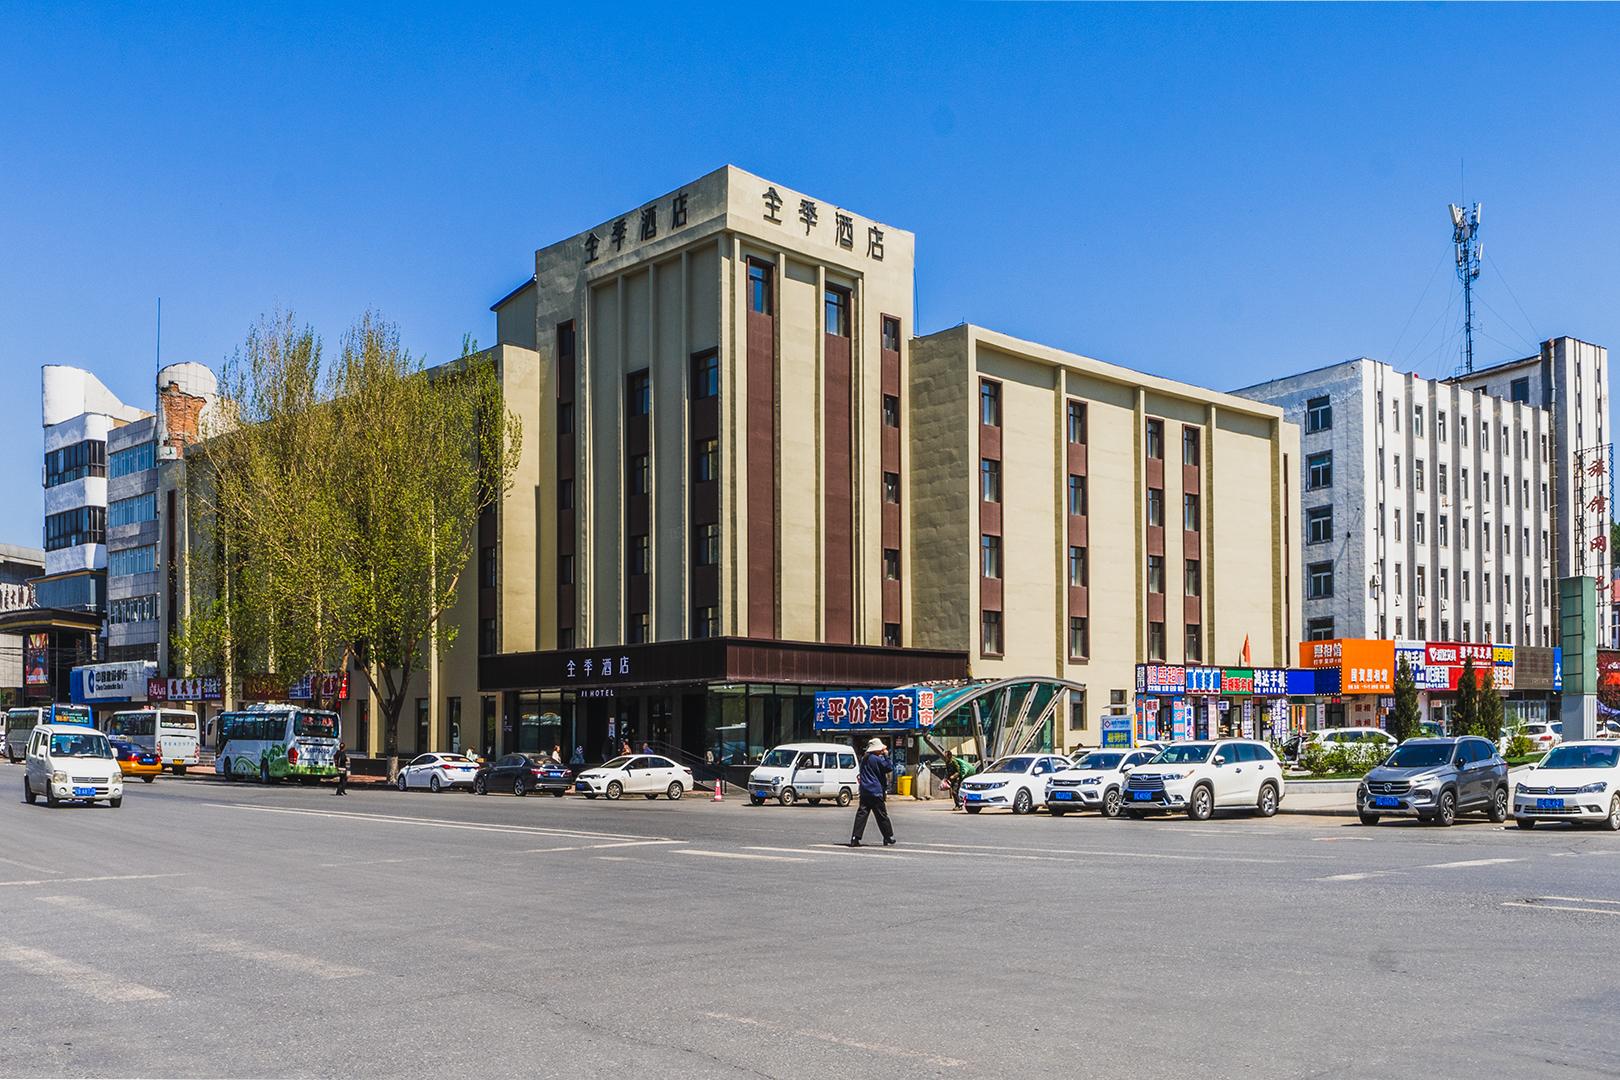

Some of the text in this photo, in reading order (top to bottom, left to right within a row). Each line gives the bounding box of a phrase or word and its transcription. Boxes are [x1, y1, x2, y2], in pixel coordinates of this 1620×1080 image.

[584, 190, 689, 264] 全季酒店
[762, 186, 885, 262] 全季酒店
[95, 668, 128, 683] 中国建设银行
[566, 656, 630, 678] 全季酒店
[590, 689, 614, 697] HOTEL
[816, 697, 826, 722] 兴旺
[827, 694, 912, 724] 平价超市
[918, 691, 934, 726] 超市
